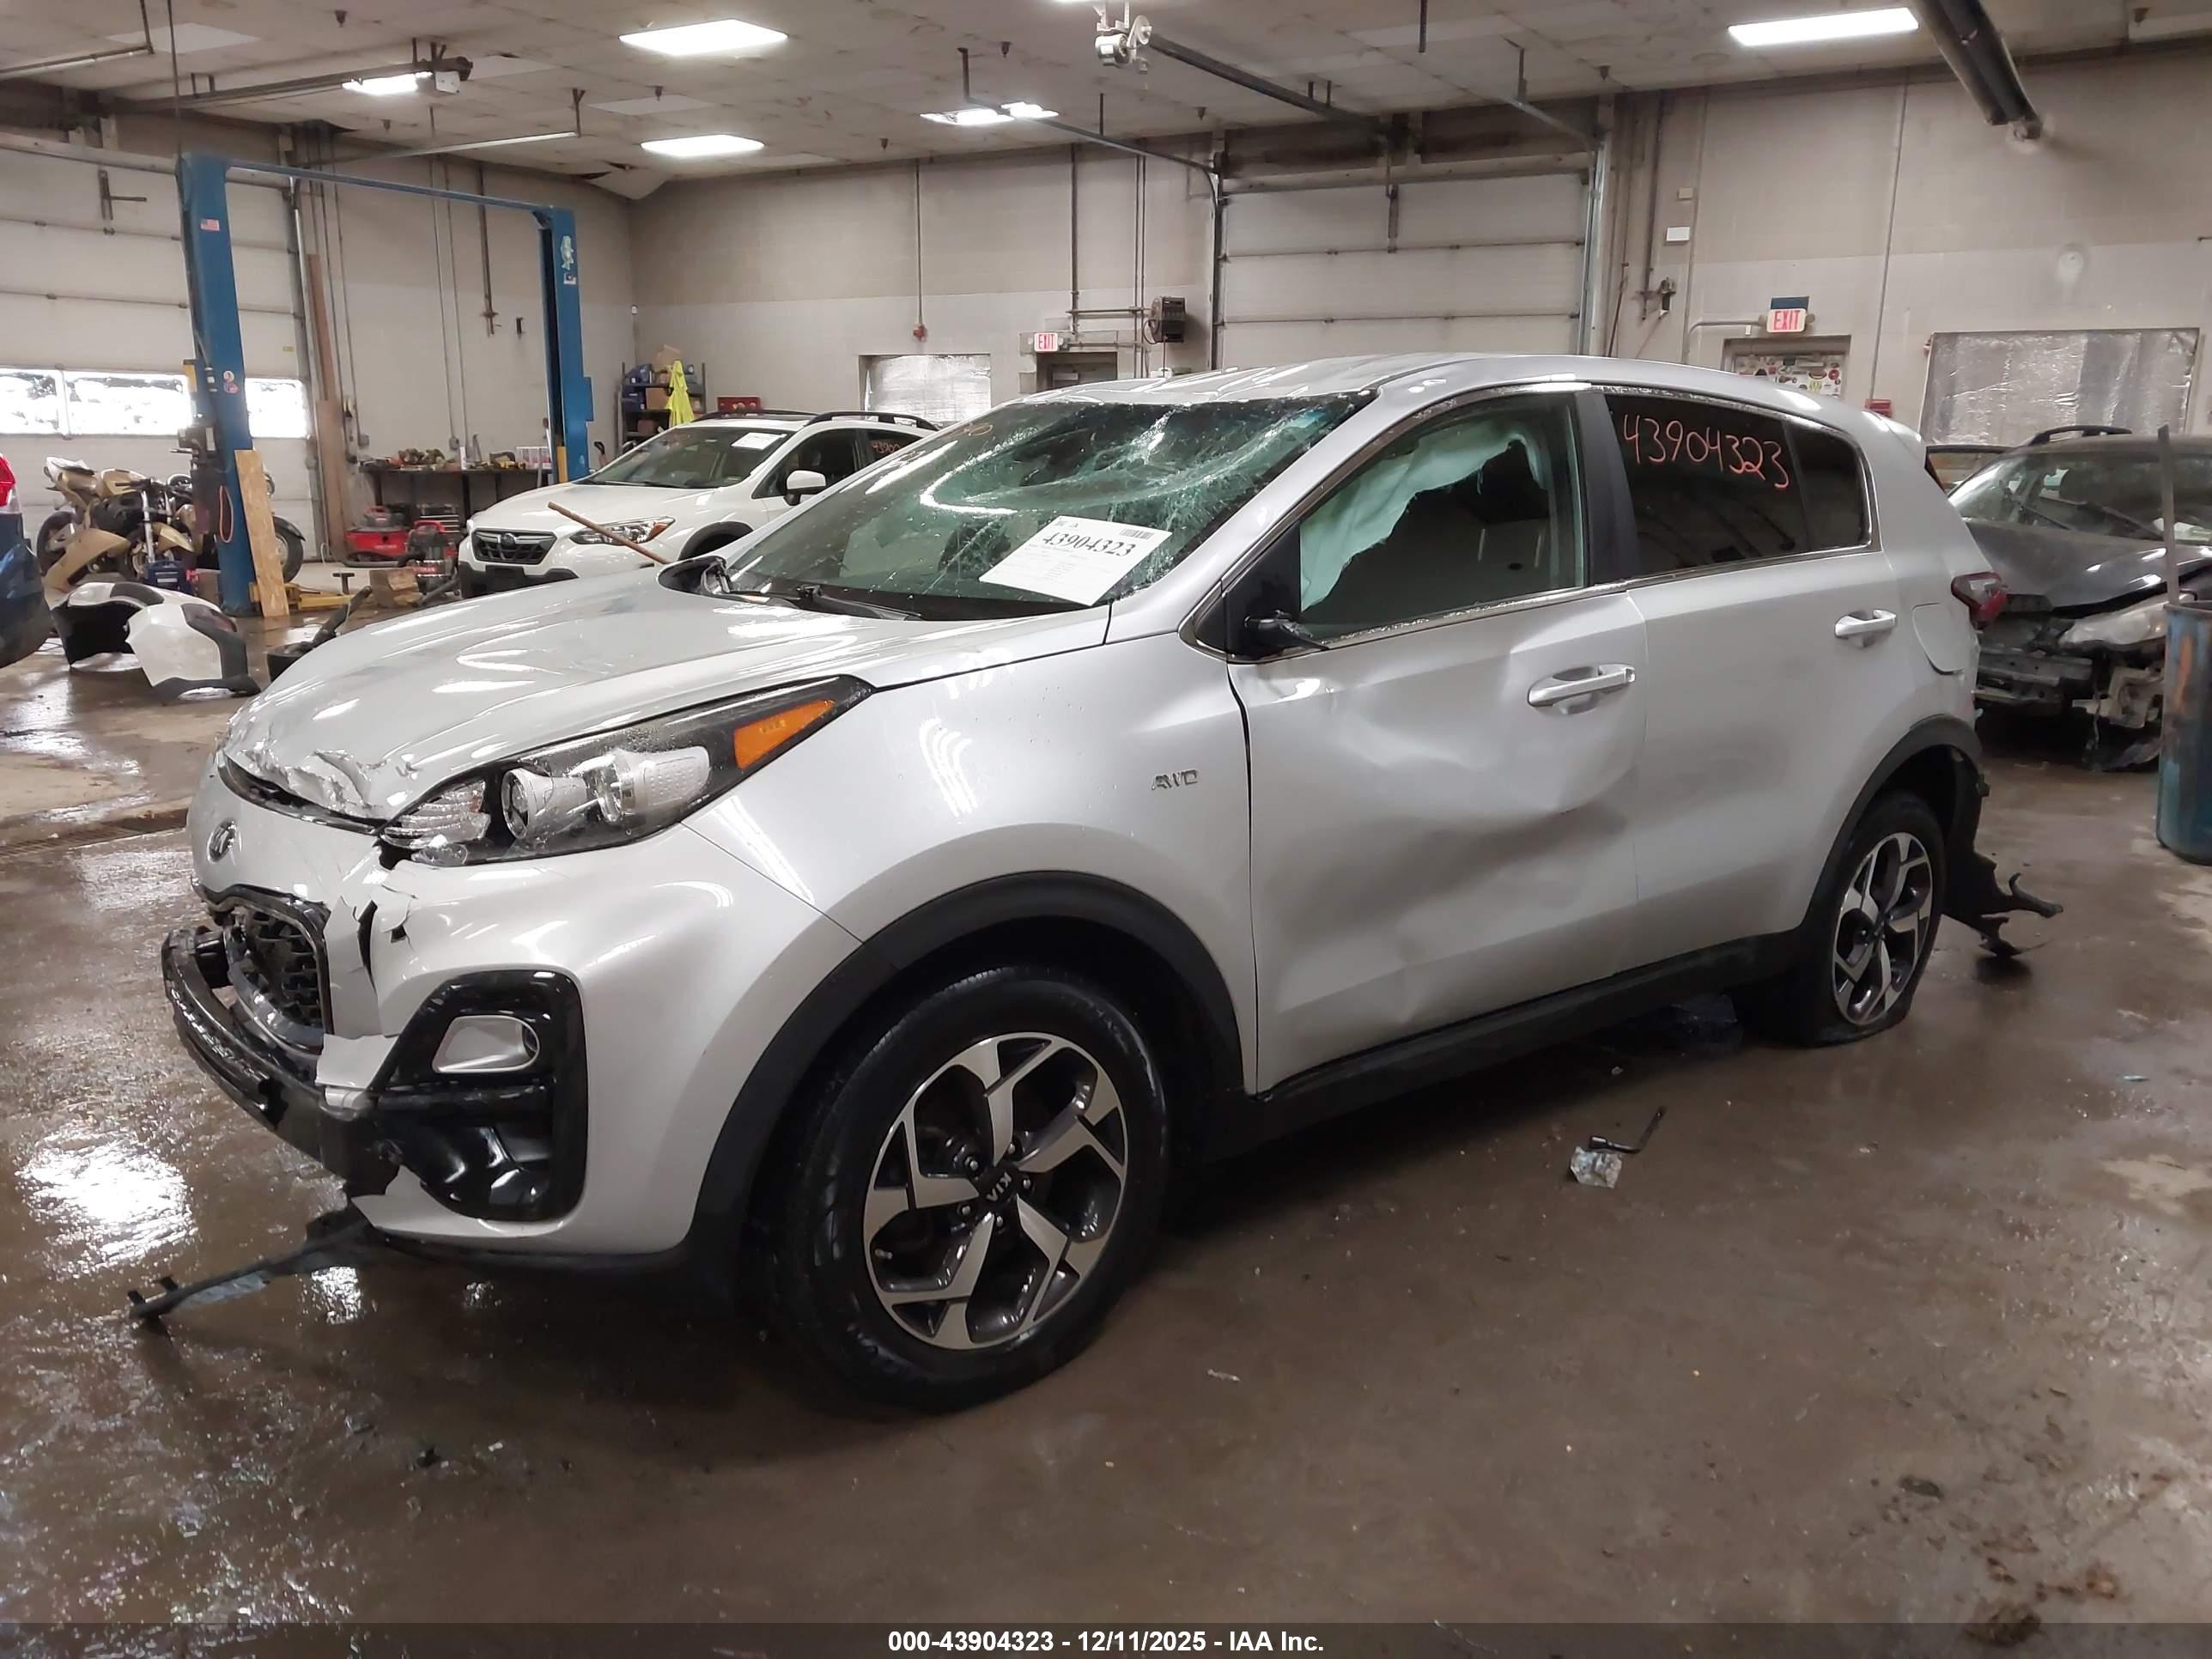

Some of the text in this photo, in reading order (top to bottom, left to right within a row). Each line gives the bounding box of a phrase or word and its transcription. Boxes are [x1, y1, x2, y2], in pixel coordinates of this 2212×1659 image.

[1773, 310, 1800, 331] EXIT
[1038, 333, 1055, 350] EXIT
[1624, 414, 1790, 489] 43904323
[1042, 532, 1136, 557] 43904323
